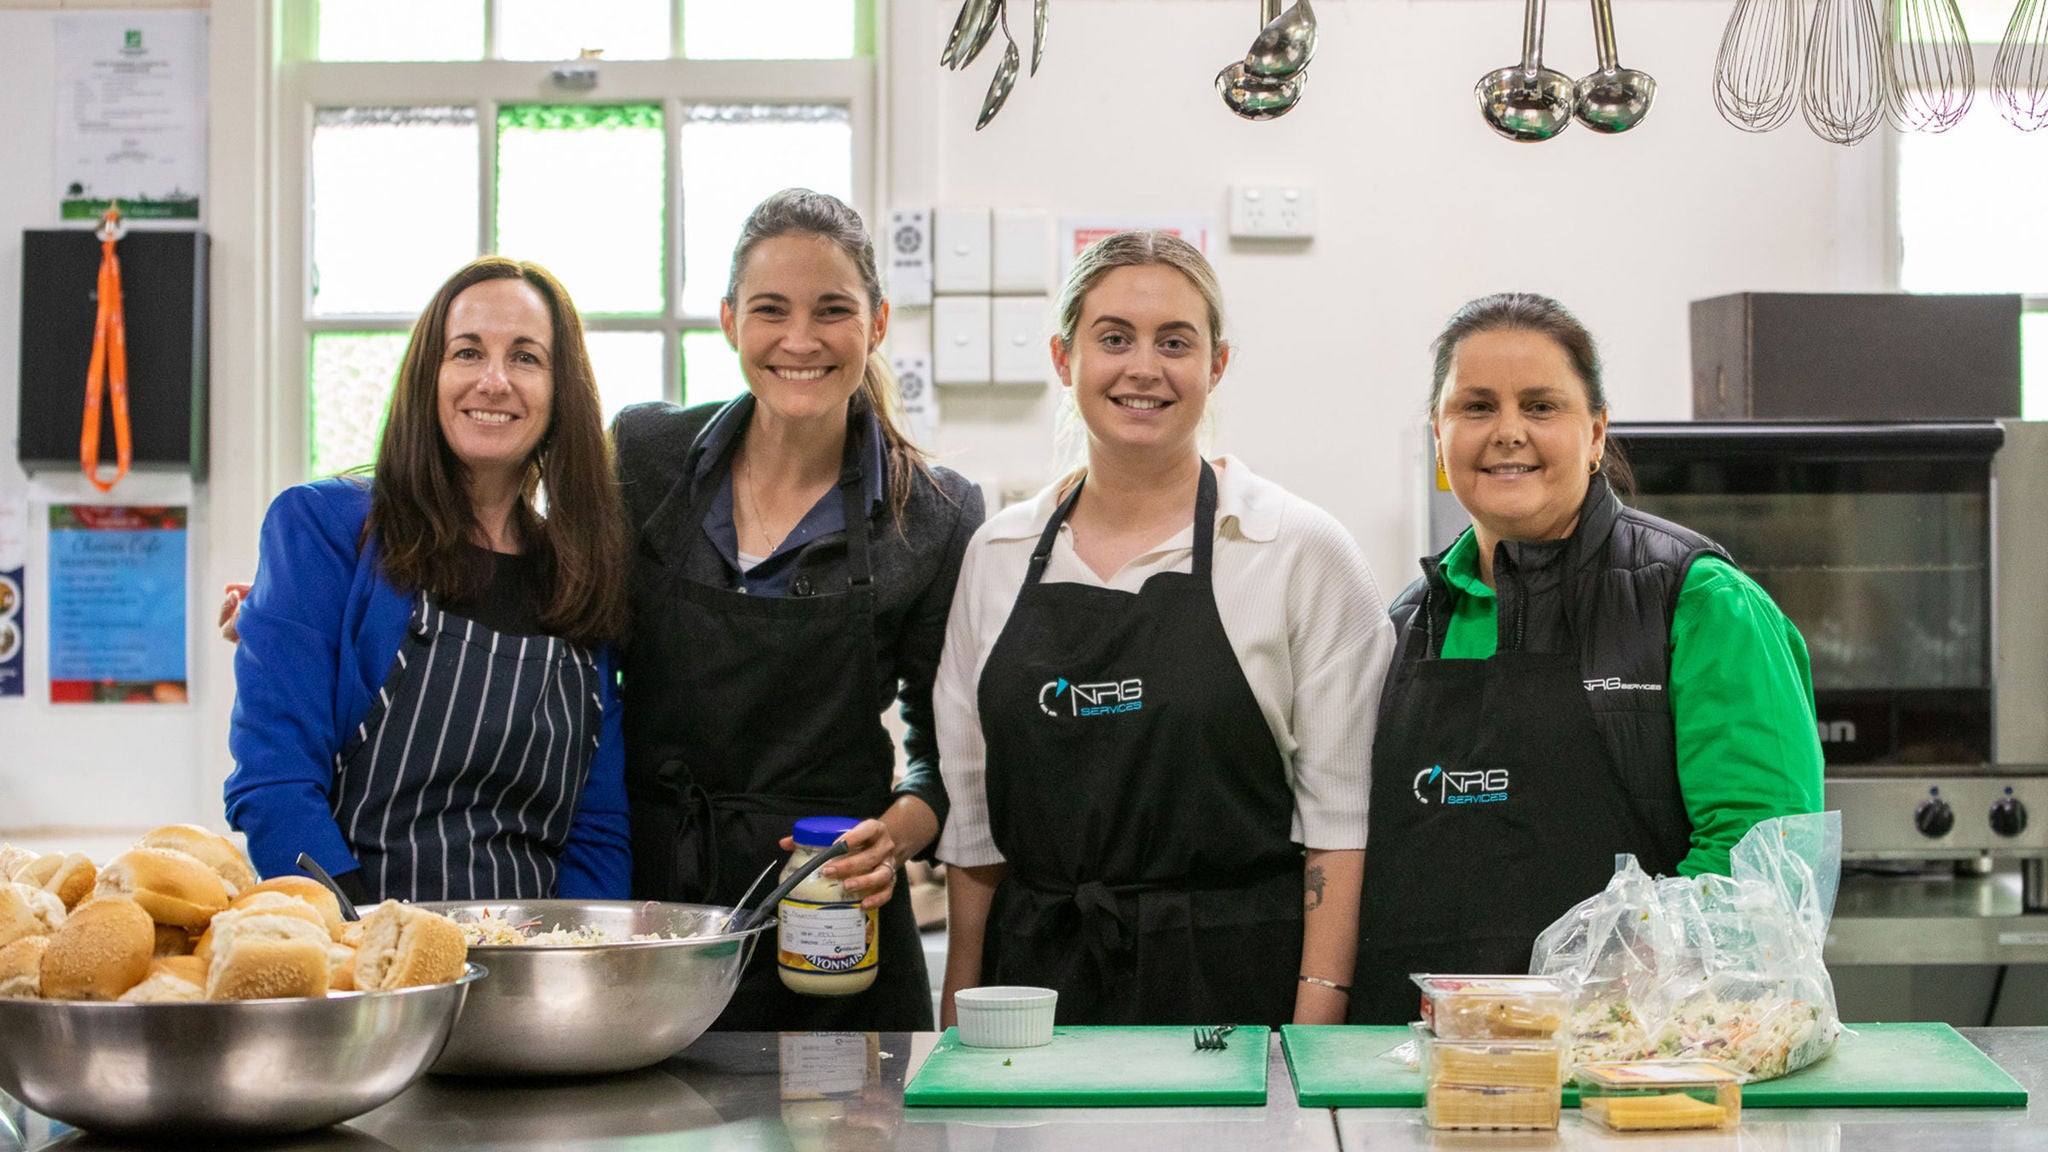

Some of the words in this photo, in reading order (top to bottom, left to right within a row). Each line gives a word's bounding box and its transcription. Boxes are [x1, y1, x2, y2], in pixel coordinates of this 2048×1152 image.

[1621, 683, 1662, 691] SERVICES
[1070, 678, 1143, 717] NRG
[1080, 701, 1143, 717] SERVICES
[1441, 768, 1509, 804] NRG
[1447, 792, 1509, 805] SERVICES
[805, 952, 864, 970] AYONNAIS
